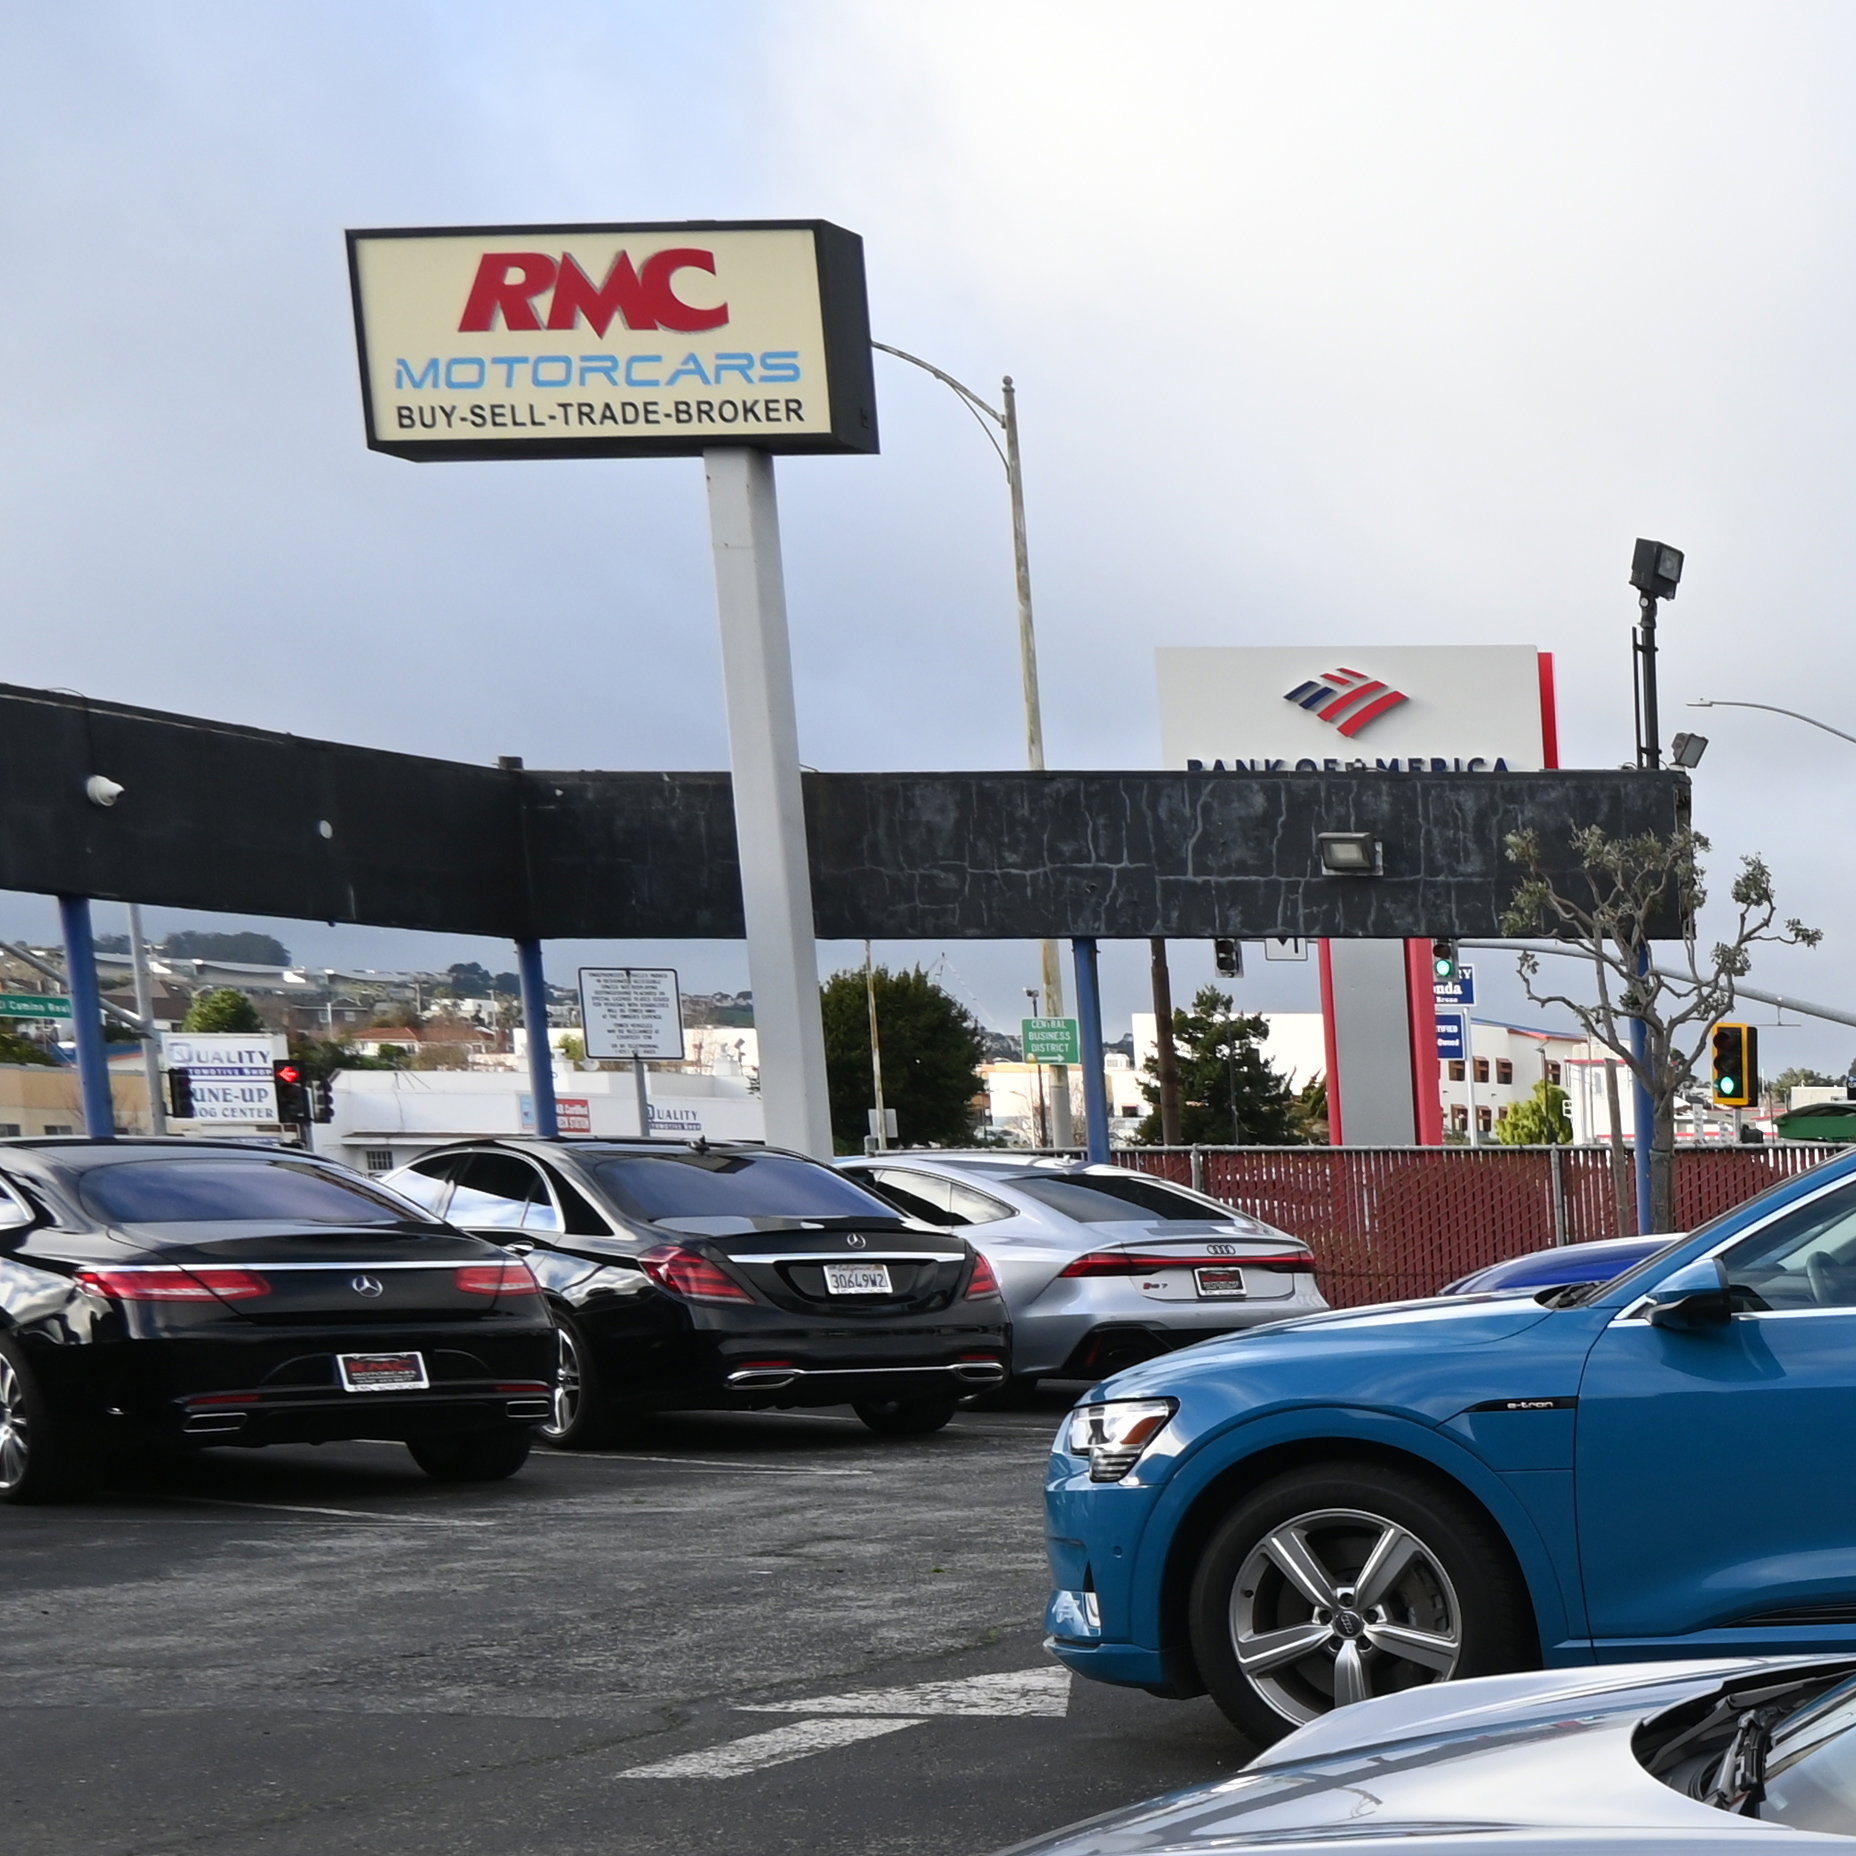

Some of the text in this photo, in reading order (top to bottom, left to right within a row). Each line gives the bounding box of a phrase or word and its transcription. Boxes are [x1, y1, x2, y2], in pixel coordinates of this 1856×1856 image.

[457, 247, 730, 340] RMC
[395, 351, 801, 390] MOTORCARS
[396, 398, 804, 430] BUY-SELL-TRADE-BROKER
[1031, 1020, 1067, 1029] CENTRAL
[1436, 1025, 1458, 1033] TIFIED
[1028, 1031, 1071, 1041] BUSINESS
[168, 1042, 271, 1065] QUALITY
[1031, 1043, 1069, 1053] DISTRICT
[188, 1067, 240, 1077] TOMOTIVE
[192, 1087, 269, 1104] UNE-UP
[221, 1107, 274, 1119] CENTER
[1507, 1401, 1554, 1409] e-tron
